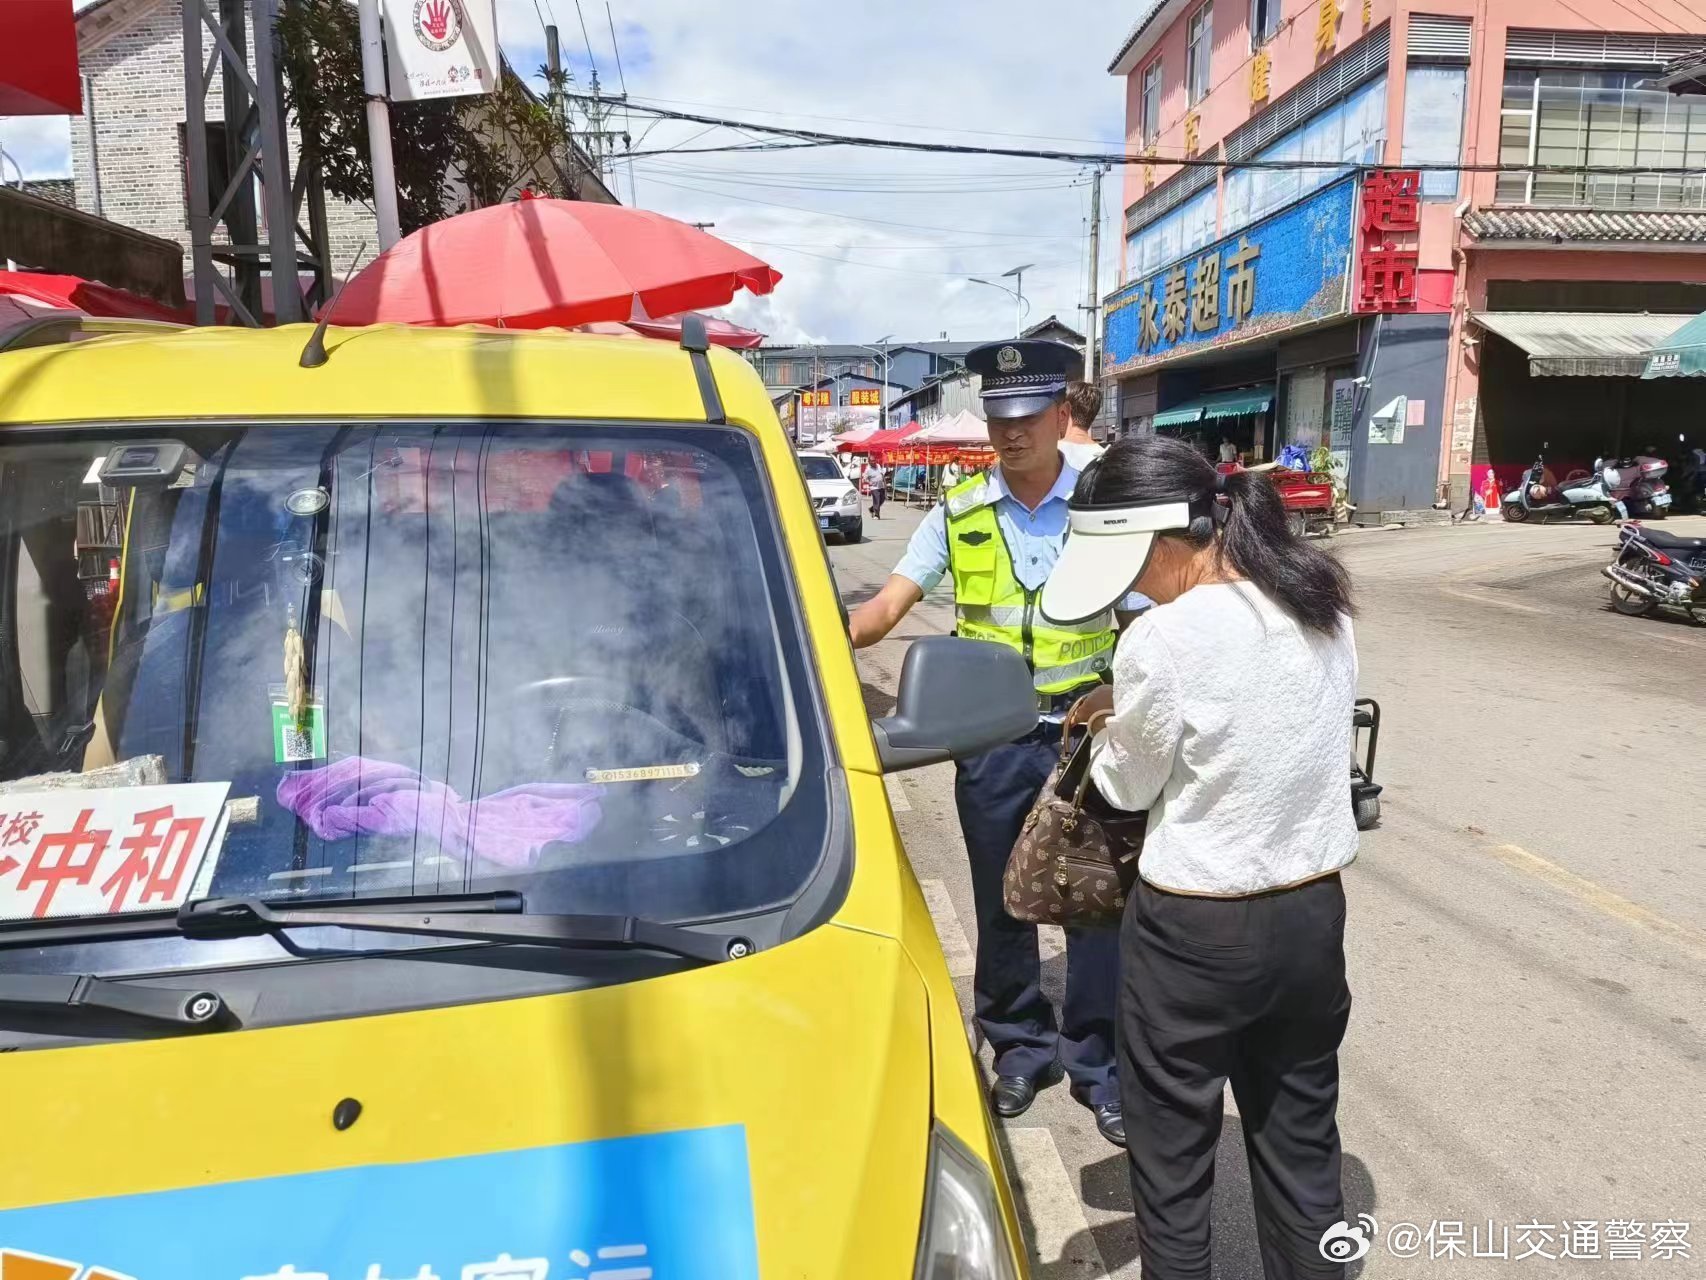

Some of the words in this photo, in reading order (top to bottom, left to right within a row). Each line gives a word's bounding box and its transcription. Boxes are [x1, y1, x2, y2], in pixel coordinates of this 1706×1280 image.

[1362, 169, 1419, 302] 超市
[1138, 237, 1261, 351] 永泰超市
[851, 390, 879, 405] 服装城
[0, 811, 44, 847] 校
[16, 804, 205, 919] 中和
